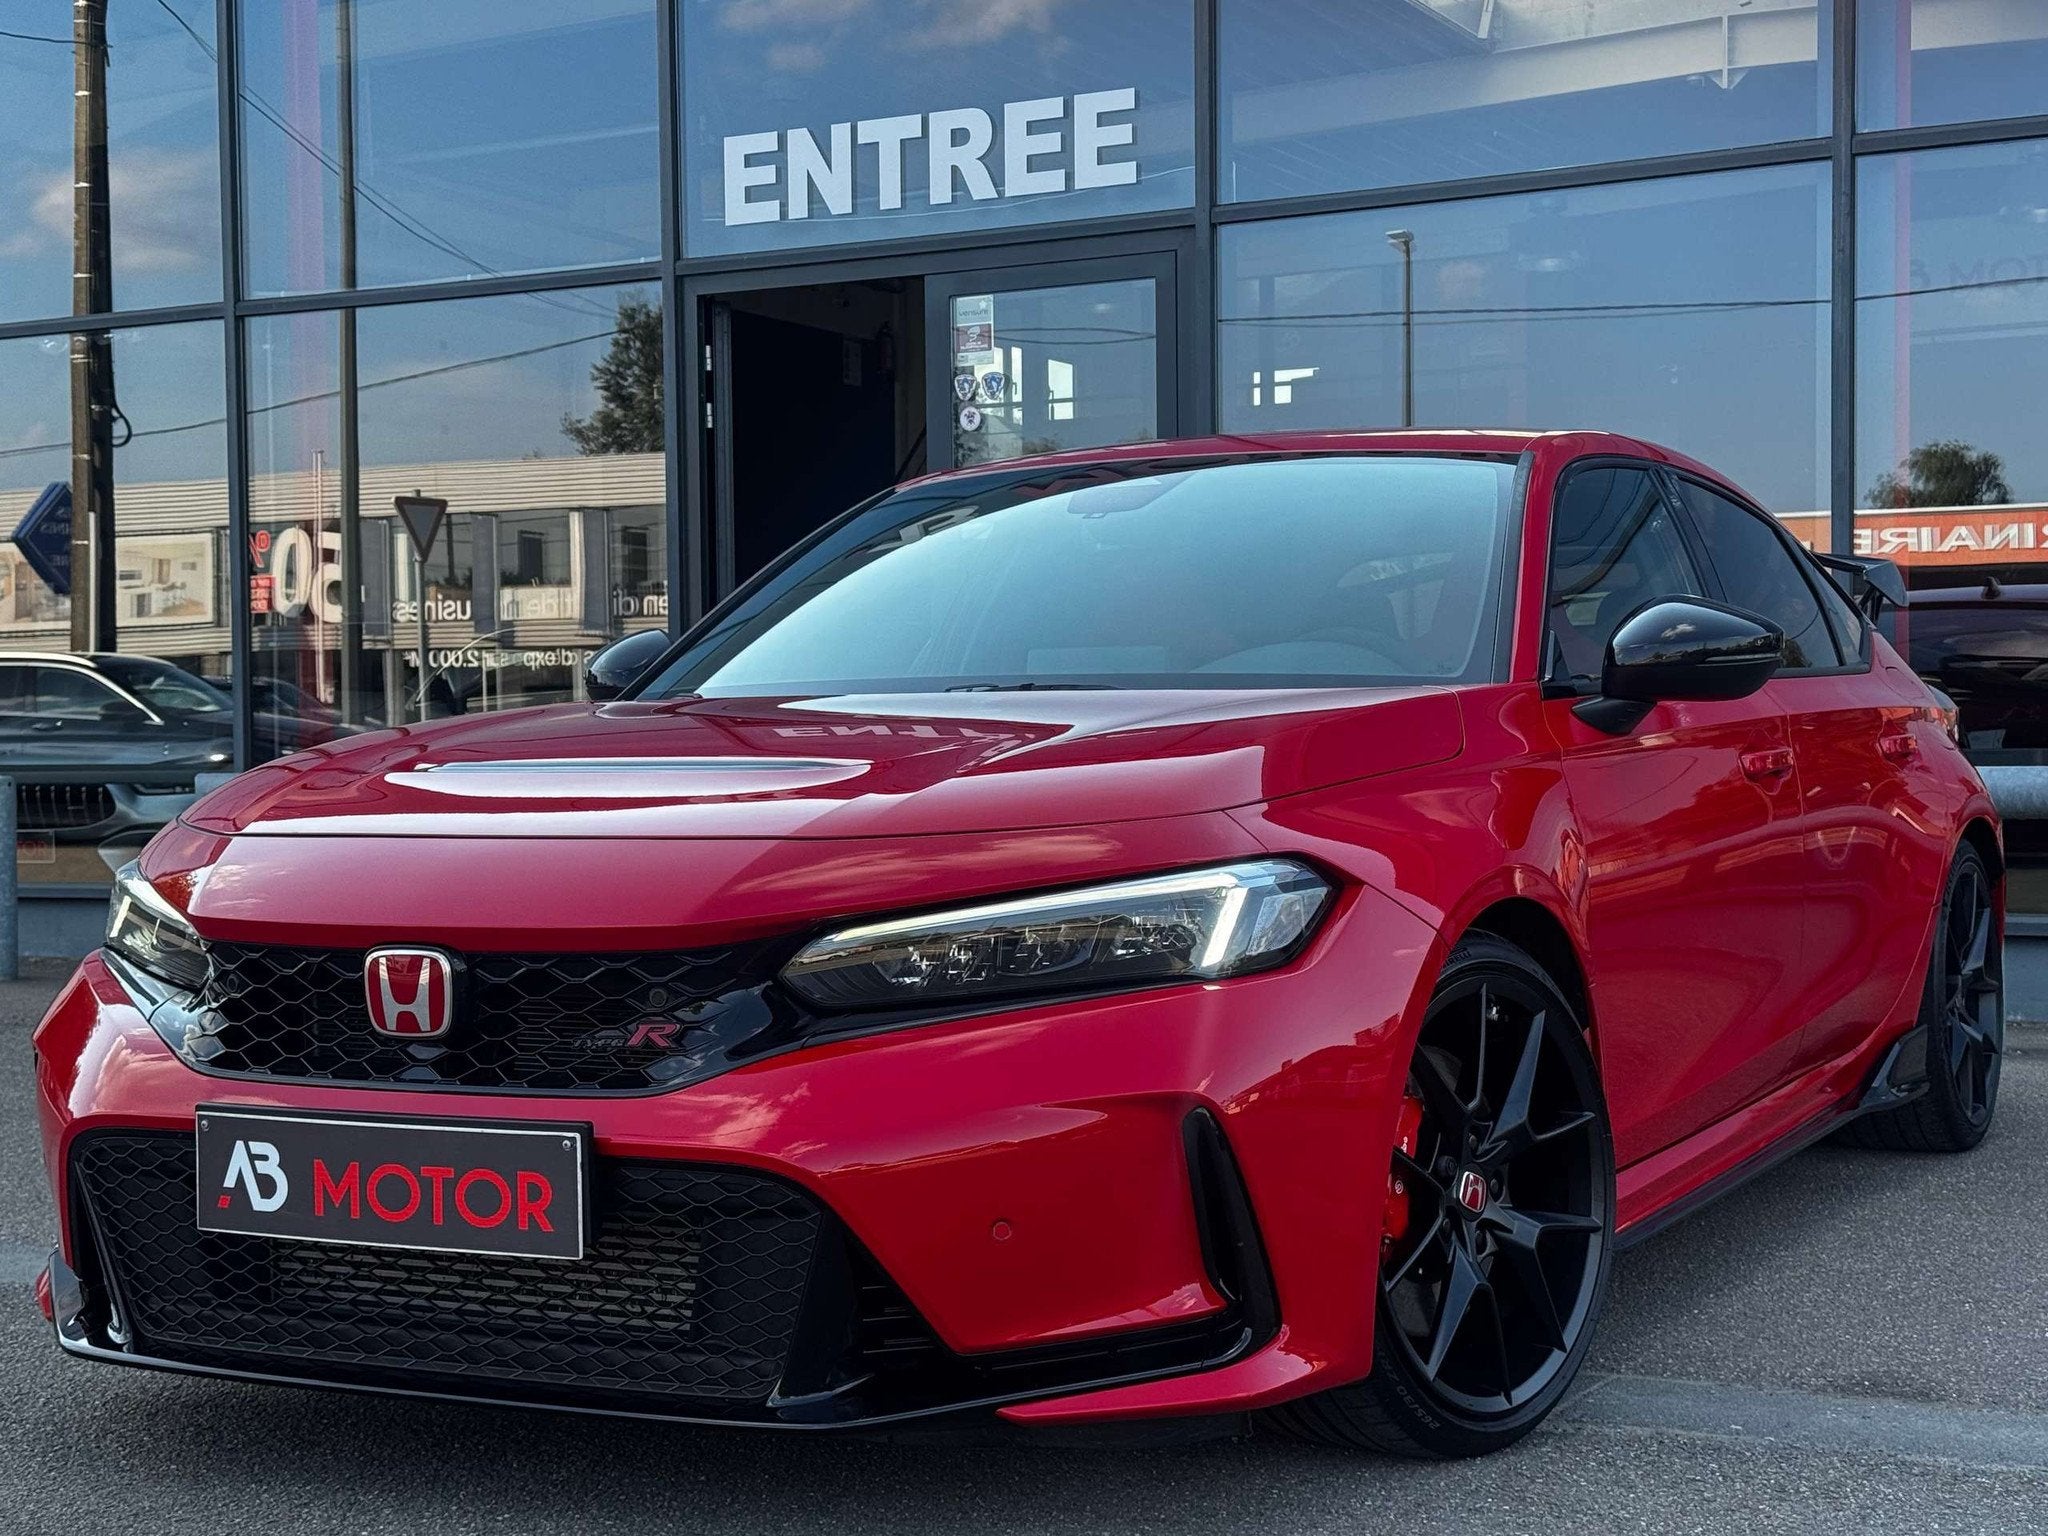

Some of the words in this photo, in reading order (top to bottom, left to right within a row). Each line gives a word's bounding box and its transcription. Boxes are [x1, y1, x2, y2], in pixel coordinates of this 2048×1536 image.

[724, 87, 1138, 226] ENTREE
[627, 1022, 681, 1048] R
[313, 1159, 555, 1233] MOTOR
